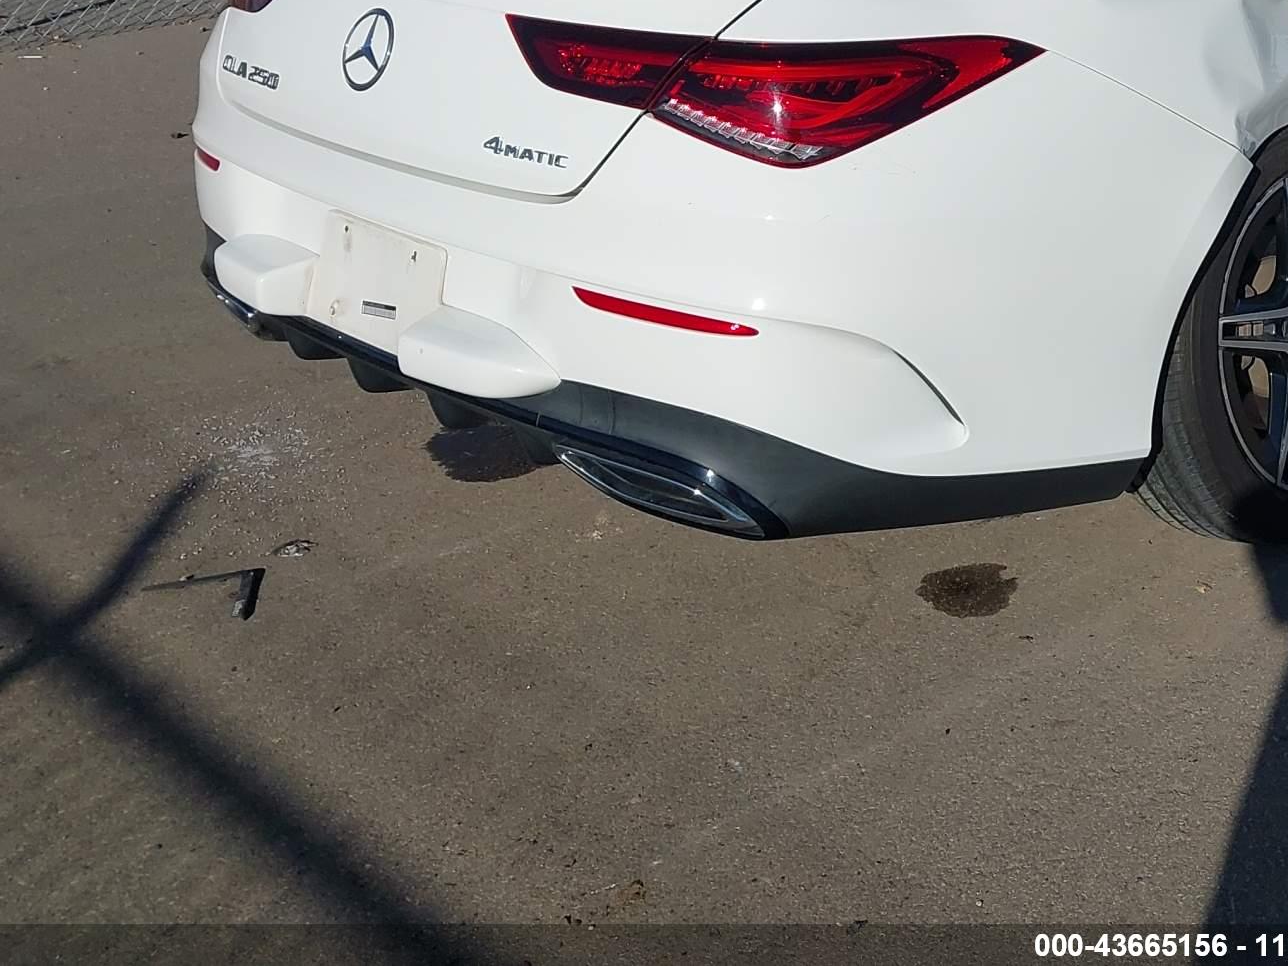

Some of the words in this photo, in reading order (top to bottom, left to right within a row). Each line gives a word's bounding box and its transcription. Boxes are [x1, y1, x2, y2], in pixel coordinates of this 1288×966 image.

[222, 54, 248, 79] CLA
[247, 65, 280, 90] 250
[483, 136, 569, 169] 4MATIC
